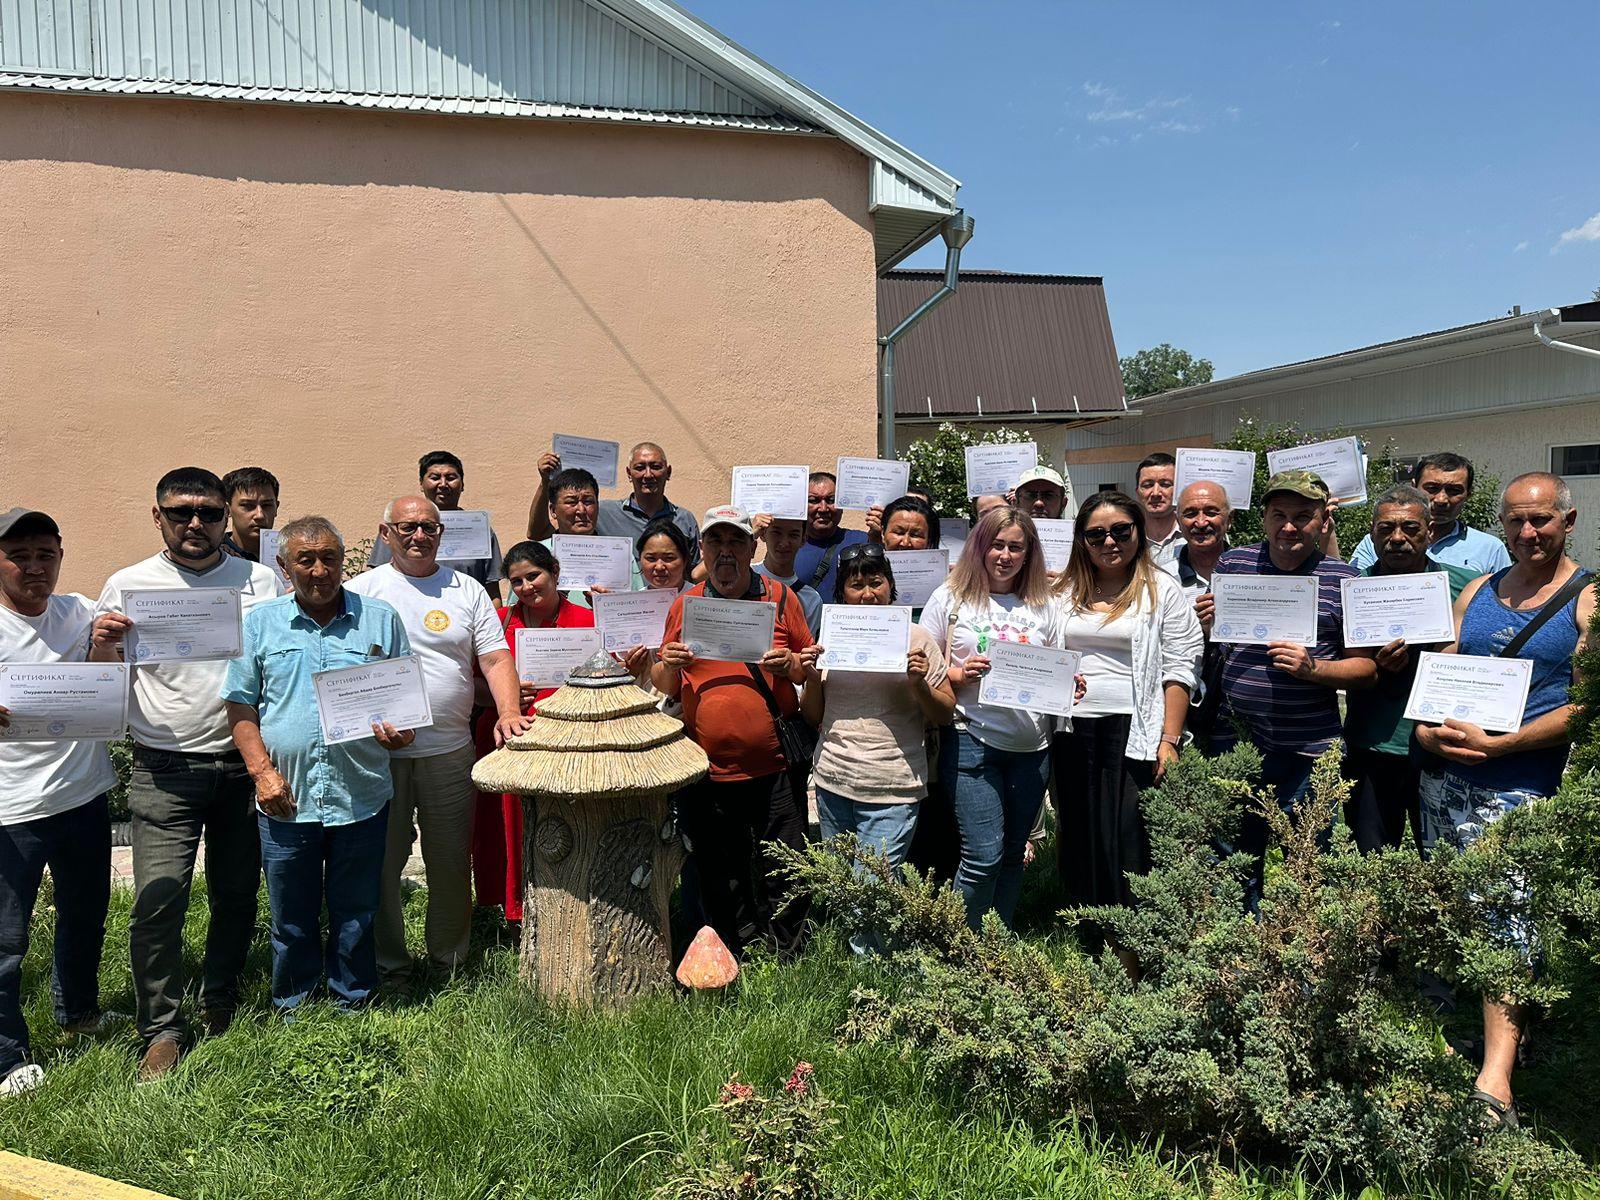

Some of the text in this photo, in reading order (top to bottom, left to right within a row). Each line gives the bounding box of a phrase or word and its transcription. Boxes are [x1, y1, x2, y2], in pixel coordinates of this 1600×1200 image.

[1222, 583, 1266, 591] СЕРТИФИКАТ
[1353, 585, 1395, 594] СЕРТИФИКАТ
[135, 599, 185, 607] СЕРТИФИКАТ
[603, 599, 639, 608] СЕРТИФИКАТ
[693, 605, 732, 614] СЕРТИФИКАТ
[832, 613, 868, 621] СЕРТИФИКАТ
[996, 648, 1035, 660] СЕРТИФИКАТ
[1431, 662, 1476, 673] СЕРТИФИКАТ
[10, 673, 67, 681] СЕРТИФИКАТ
[326, 673, 371, 687] СЕРТИФИКАТ
